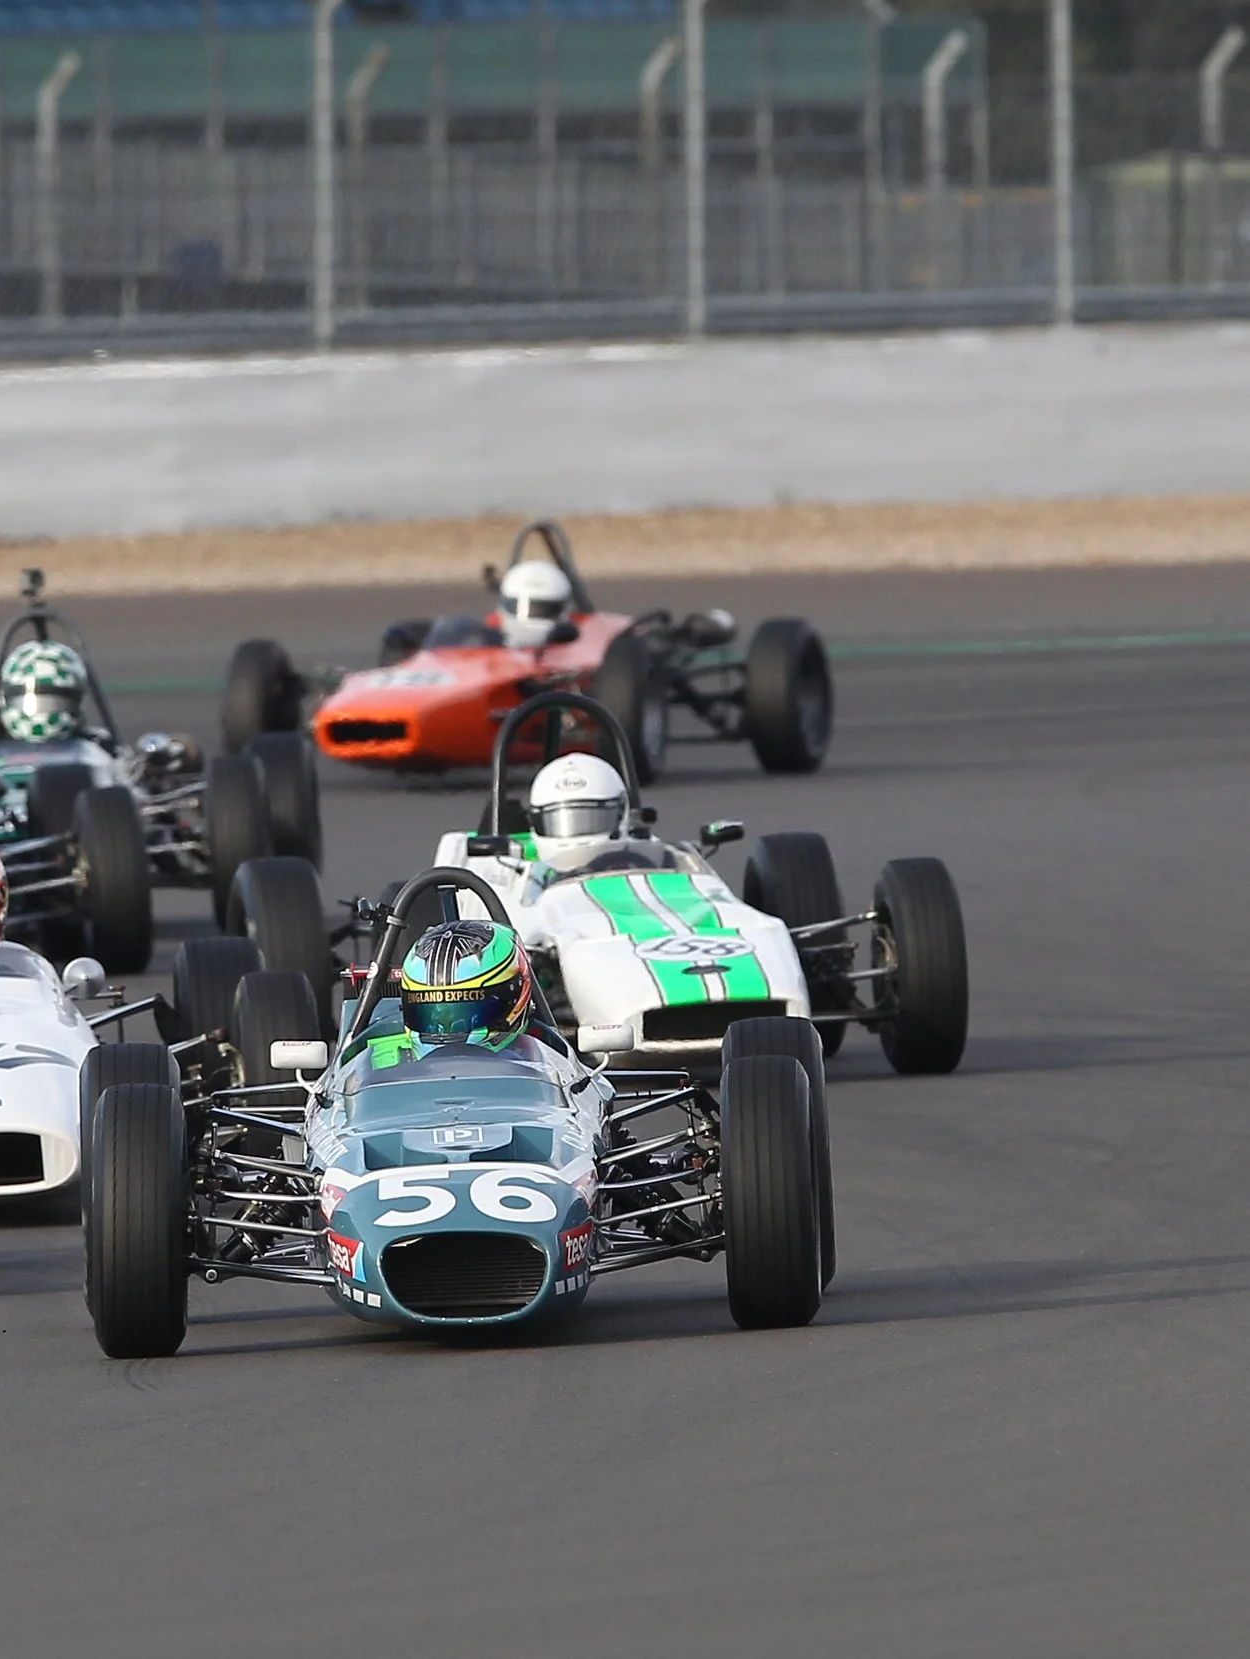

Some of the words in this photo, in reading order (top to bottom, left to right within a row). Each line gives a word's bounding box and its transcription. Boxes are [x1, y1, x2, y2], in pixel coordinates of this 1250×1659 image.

[408, 991, 443, 1003] ENGLAND
[445, 989, 485, 1002] EXPECTS
[374, 1169, 558, 1227] 56
